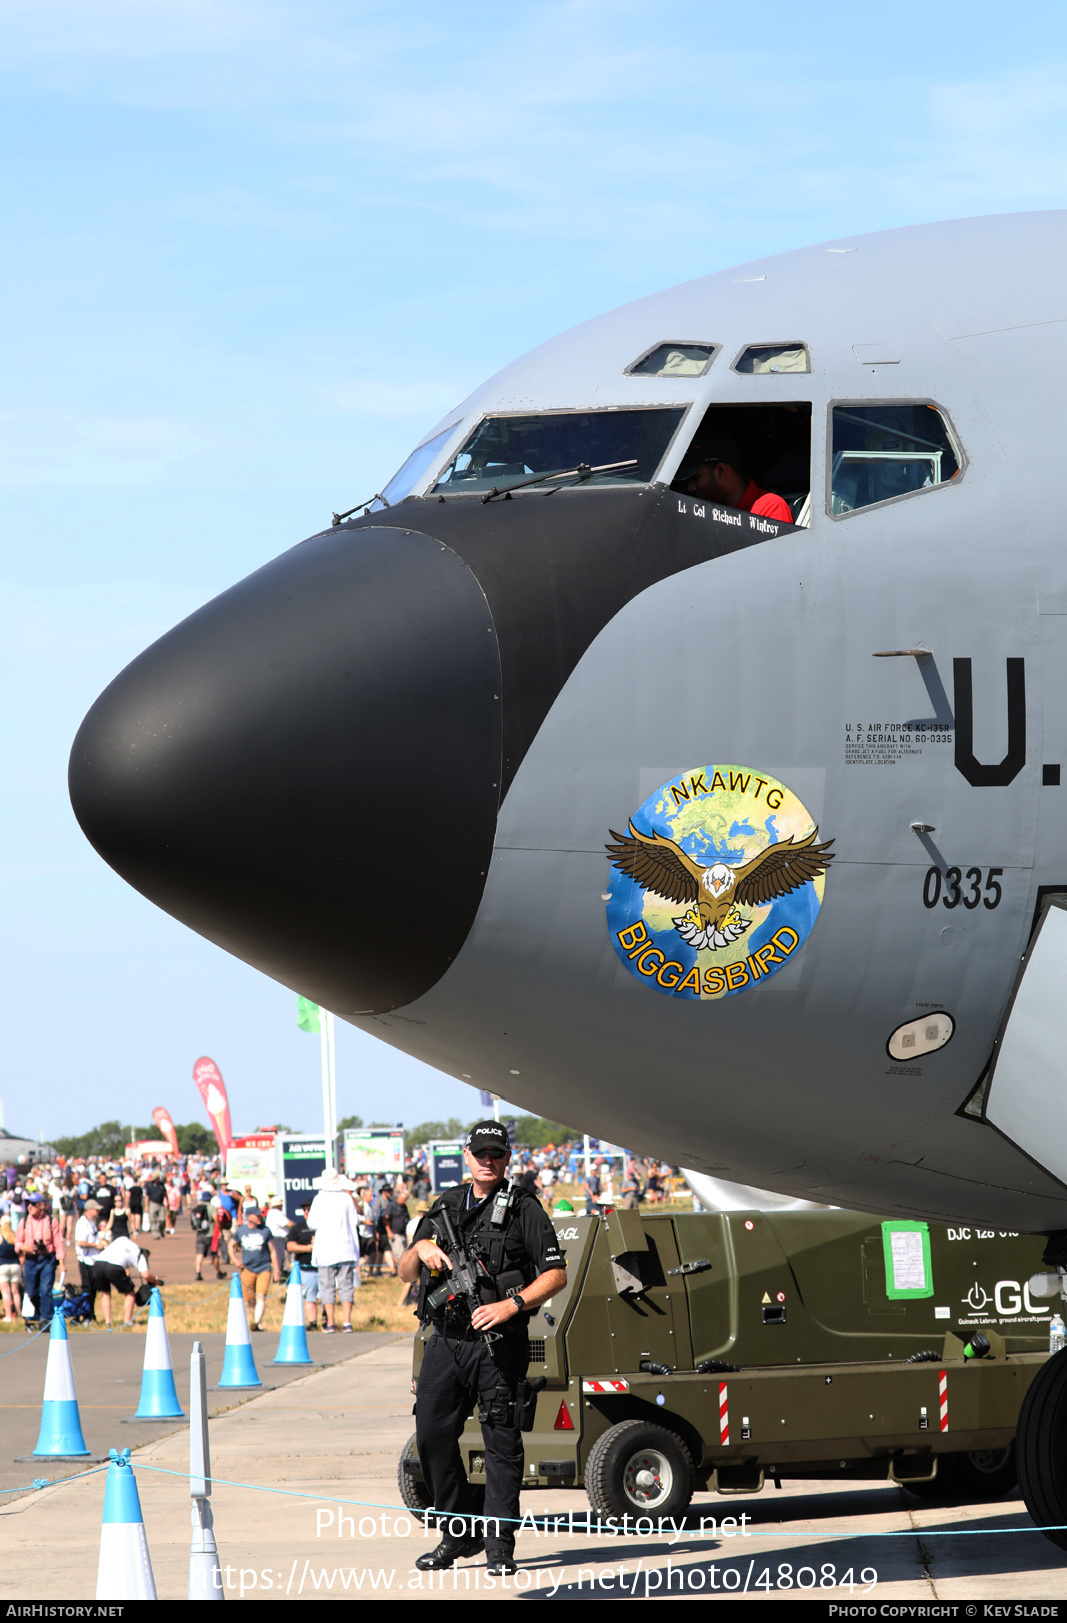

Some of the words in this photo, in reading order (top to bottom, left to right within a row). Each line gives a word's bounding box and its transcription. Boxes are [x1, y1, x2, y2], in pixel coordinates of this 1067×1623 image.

[678, 500, 687, 513] Lt
[693, 504, 705, 518] Col
[712, 508, 742, 526] Richard
[749, 516, 779, 536] Winfrey
[845, 724, 854, 732] U.
[857, 724, 865, 732] S.
[868, 724, 882, 732] AIR
[884, 724, 913, 732] FORCE
[915, 724, 950, 732] KC-135R
[845, 734, 854, 743] A.
[857, 734, 864, 743] F.
[867, 734, 897, 743] SERIAL
[900, 734, 913, 743] NO.
[915, 734, 952, 743] 60-0335
[953, 657, 1060, 787] U.
[670, 770, 785, 810] NKAWTG
[923, 866, 1003, 910] 0335
[616, 920, 800, 995] BIGGASBIRD
[475, 1127, 503, 1136] POLICE
[947, 1227, 971, 1241] DJC
